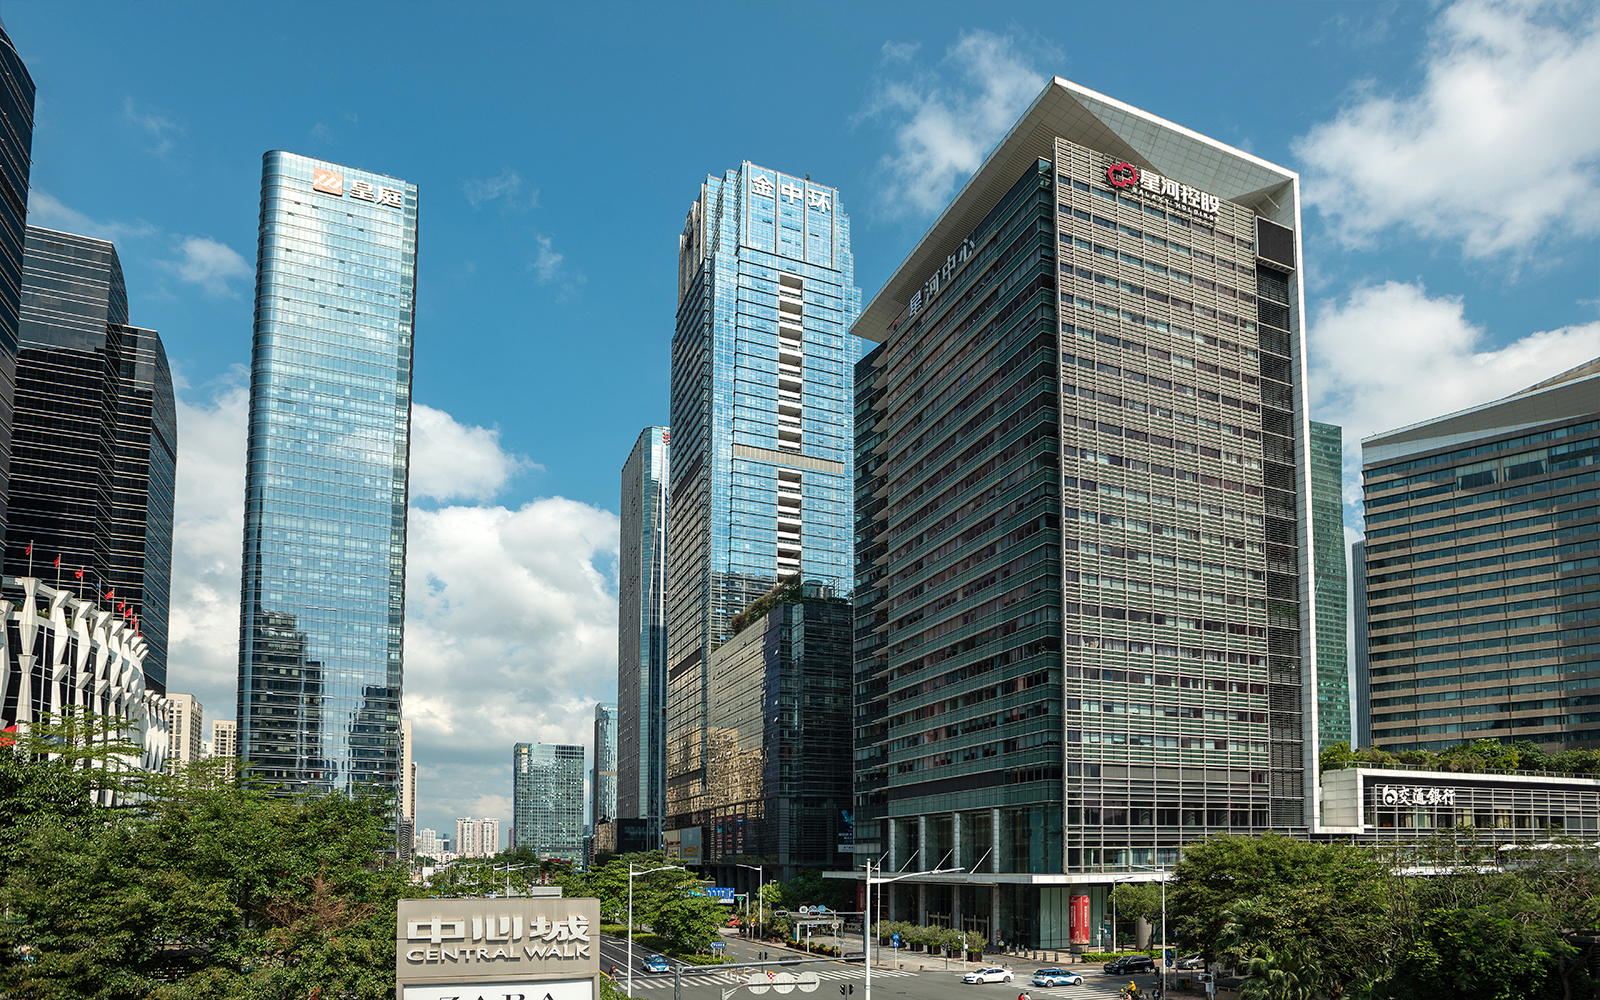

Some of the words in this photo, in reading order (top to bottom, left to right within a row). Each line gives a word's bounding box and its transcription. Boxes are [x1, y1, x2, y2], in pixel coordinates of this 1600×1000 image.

[349, 179, 402, 209] 皇庭
[751, 174, 831, 214] 金中环
[1140, 168, 1220, 216] 星河控股
[910, 238, 976, 319] 星河中心
[407, 915, 590, 945] 中心城
[406, 946, 521, 963] CENTRAL
[524, 944, 591, 960] WALK
